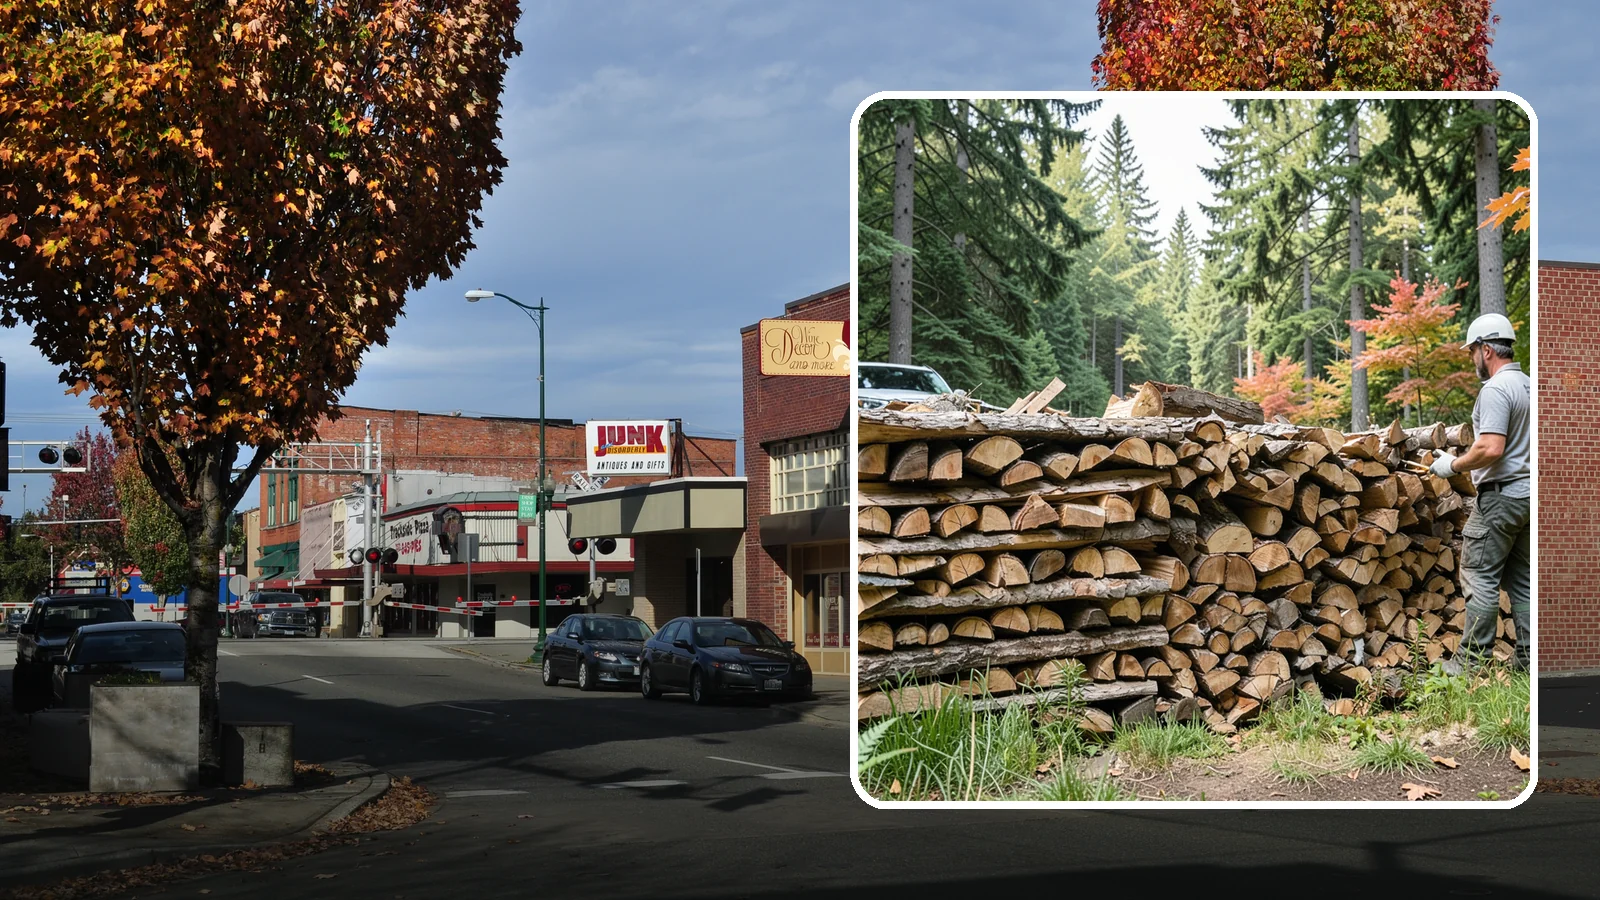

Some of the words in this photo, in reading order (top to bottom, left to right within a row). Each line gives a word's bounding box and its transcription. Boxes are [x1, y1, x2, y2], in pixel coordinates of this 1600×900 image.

[595, 425, 665, 457] JUNK
[607, 445, 645, 454] DISORDERLY
[597, 460, 628, 470] ANTIQUES
[631, 460, 644, 470] AND
[647, 460, 665, 470] GIFTS
